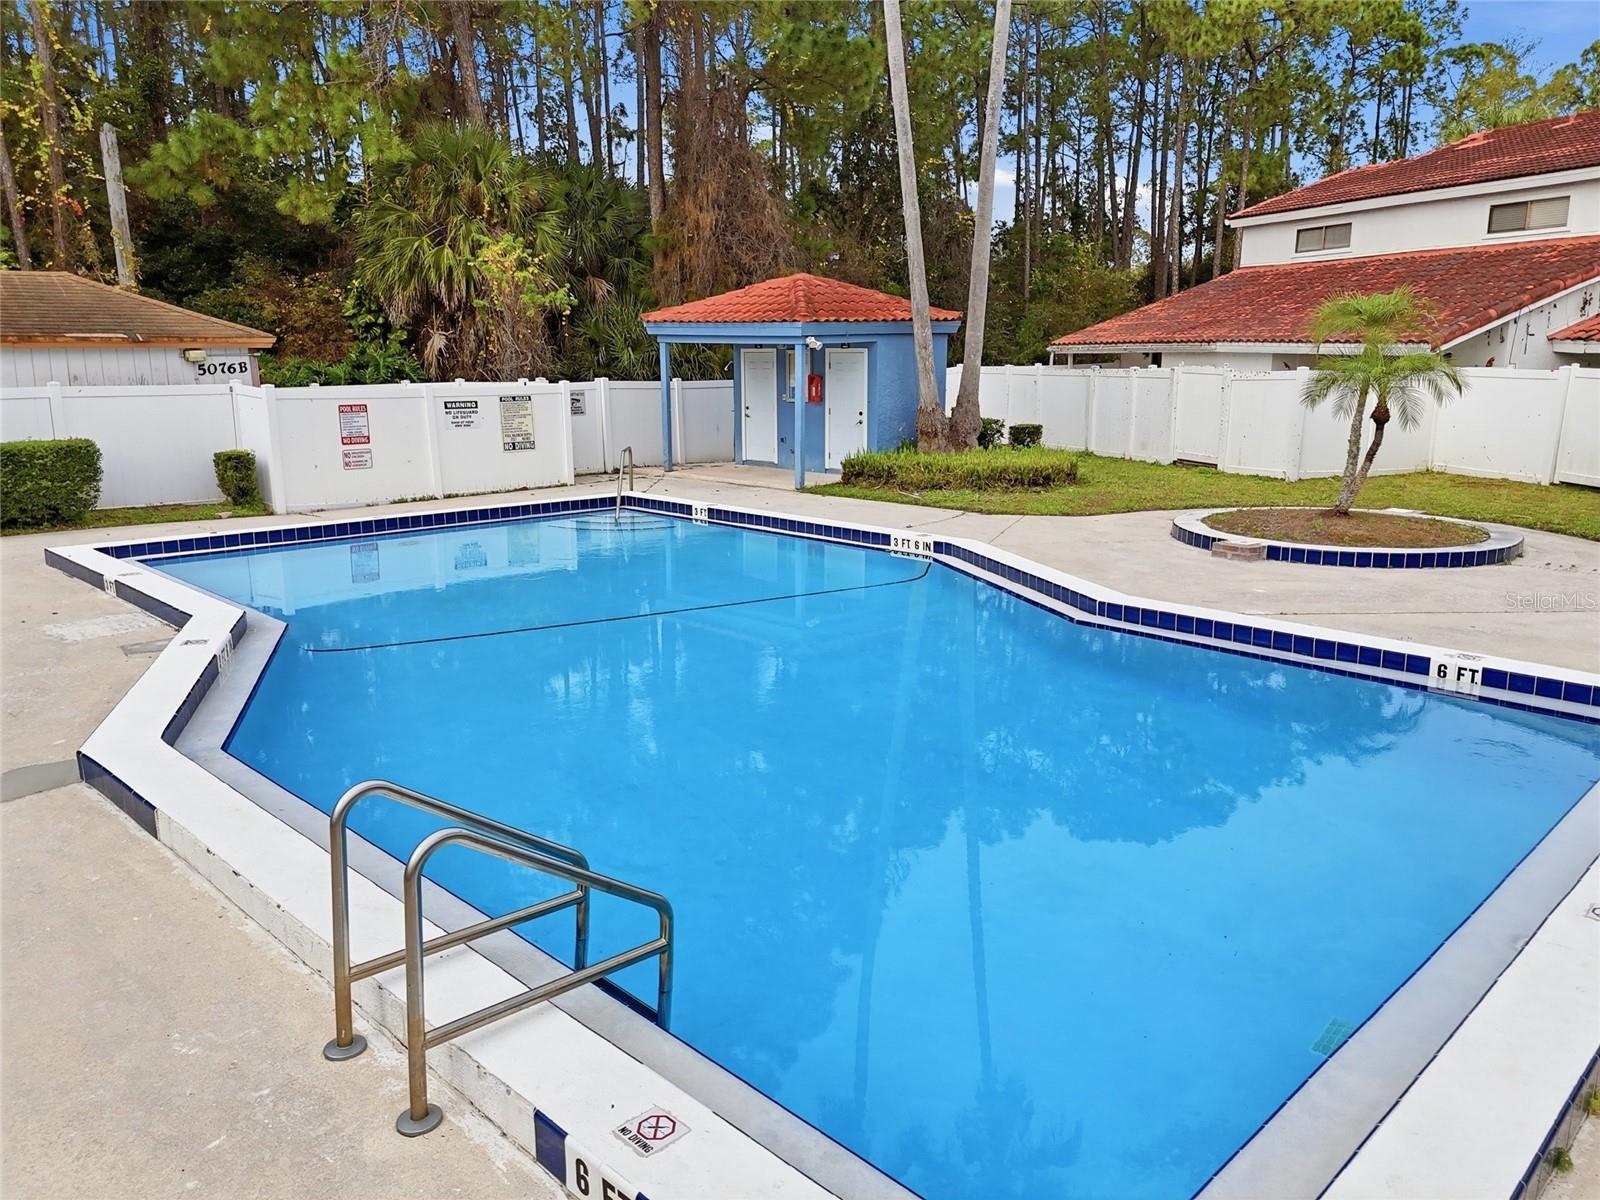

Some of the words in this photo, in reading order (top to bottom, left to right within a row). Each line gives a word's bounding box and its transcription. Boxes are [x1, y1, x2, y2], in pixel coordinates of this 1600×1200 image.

[198, 361, 248, 376] 5076B
[504, 442, 514, 450] NO
[514, 441, 535, 450] DIVING
[893, 537, 899, 548] 3
[901, 538, 911, 549] FT
[914, 540, 920, 550] 6
[923, 541, 932, 552] IN
[1437, 663, 1448, 679] 6
[618, 1126, 629, 1137] NO
[628, 1132, 653, 1153] DIVING
[576, 1158, 589, 1196] 6
